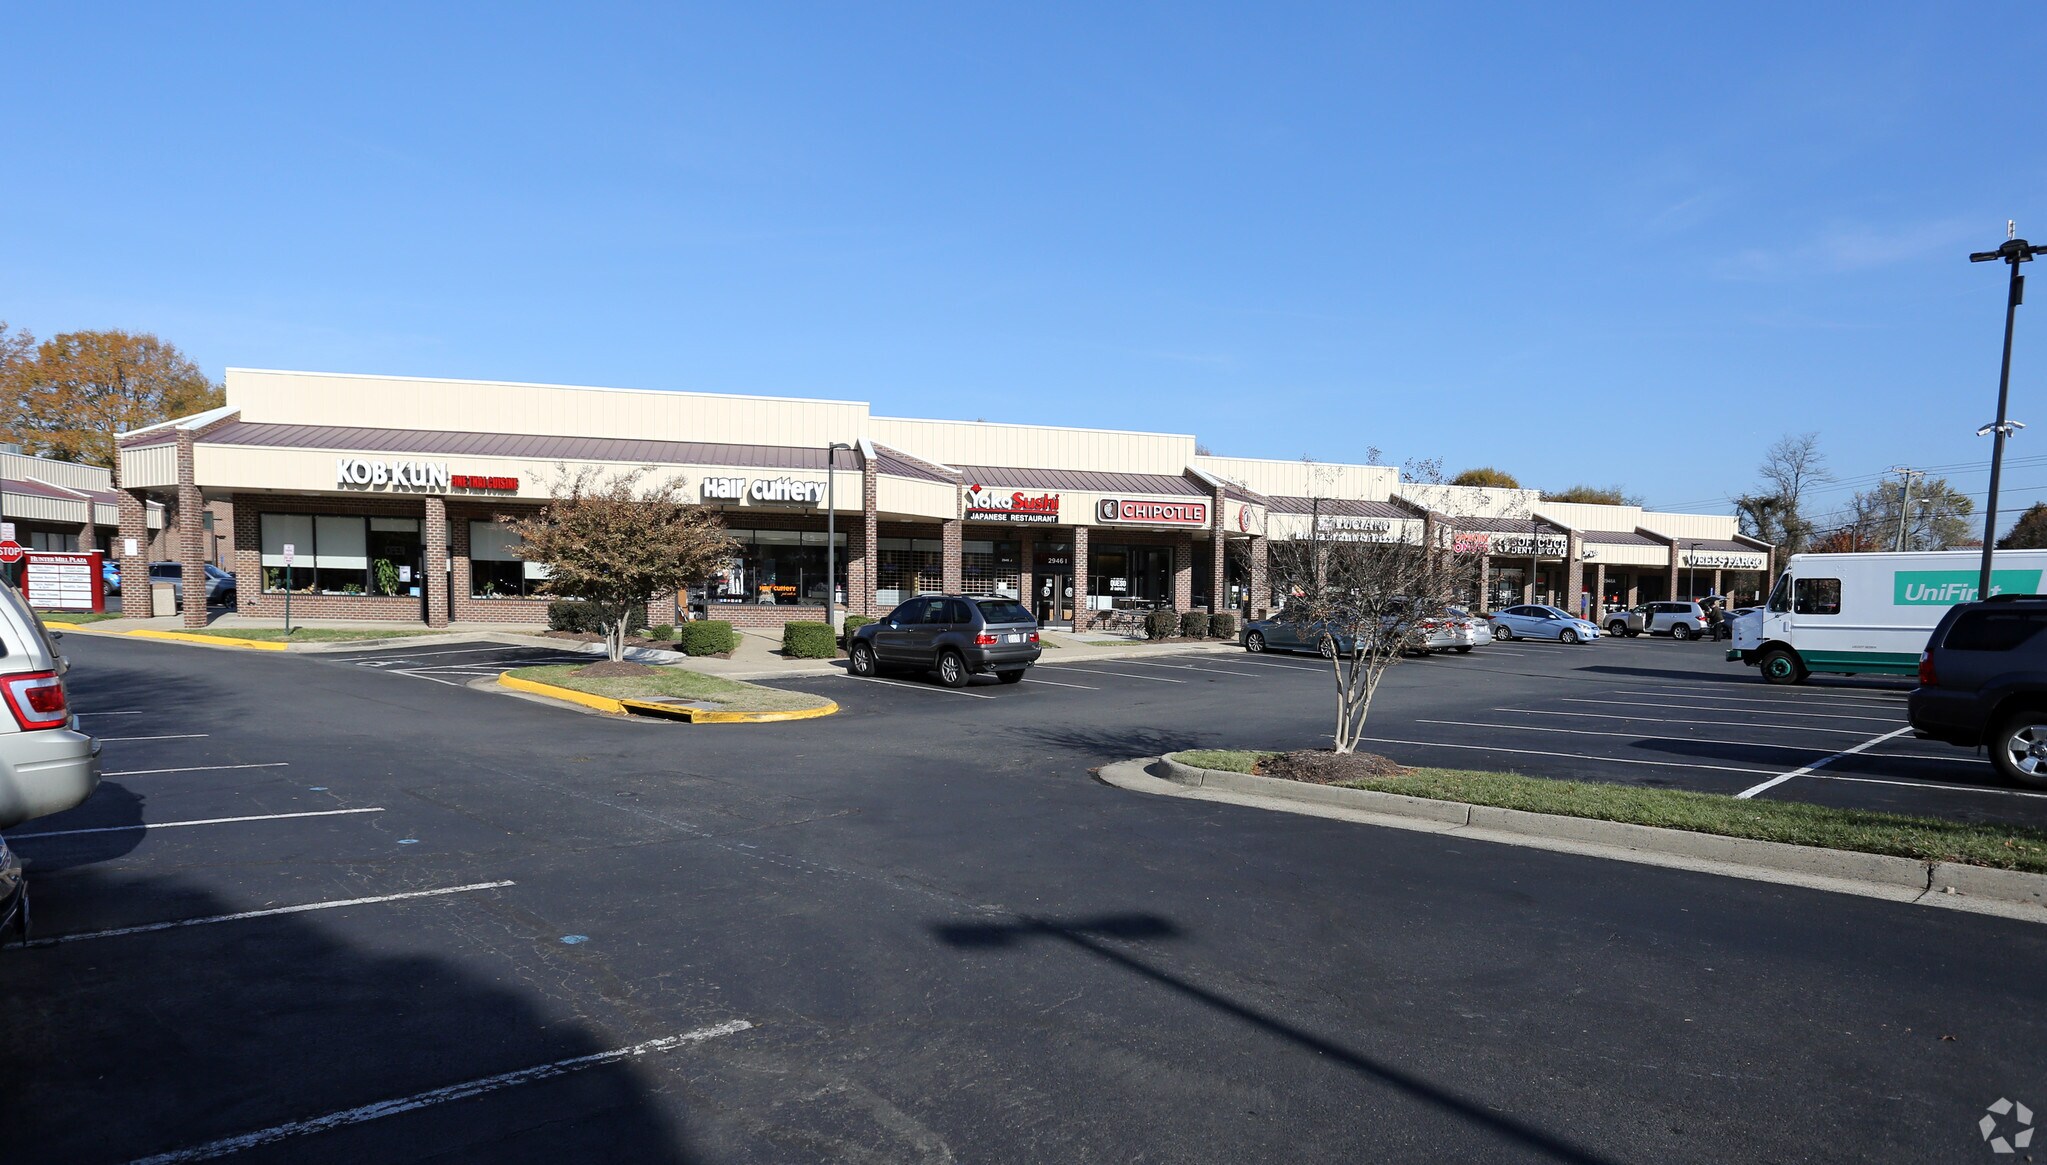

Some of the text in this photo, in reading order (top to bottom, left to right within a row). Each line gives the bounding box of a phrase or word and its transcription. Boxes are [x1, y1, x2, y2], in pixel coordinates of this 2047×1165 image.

[336, 458, 448, 487] KOB KUN
[451, 475, 518, 490] FINE THAI CUISINE
[703, 477, 745, 499] Hair
[969, 490, 1060, 511] Yoko Sushi
[970, 511, 1057, 523] JAPANESE RESTAURANT
[1123, 504, 1203, 521] CHIPOTLE
[0, 547, 20, 556] STOP
[1546, 547, 1567, 556] CARE
[1687, 554, 1763, 567] WELLS FARGO
[1904, 583, 2002, 601] UniFirt
